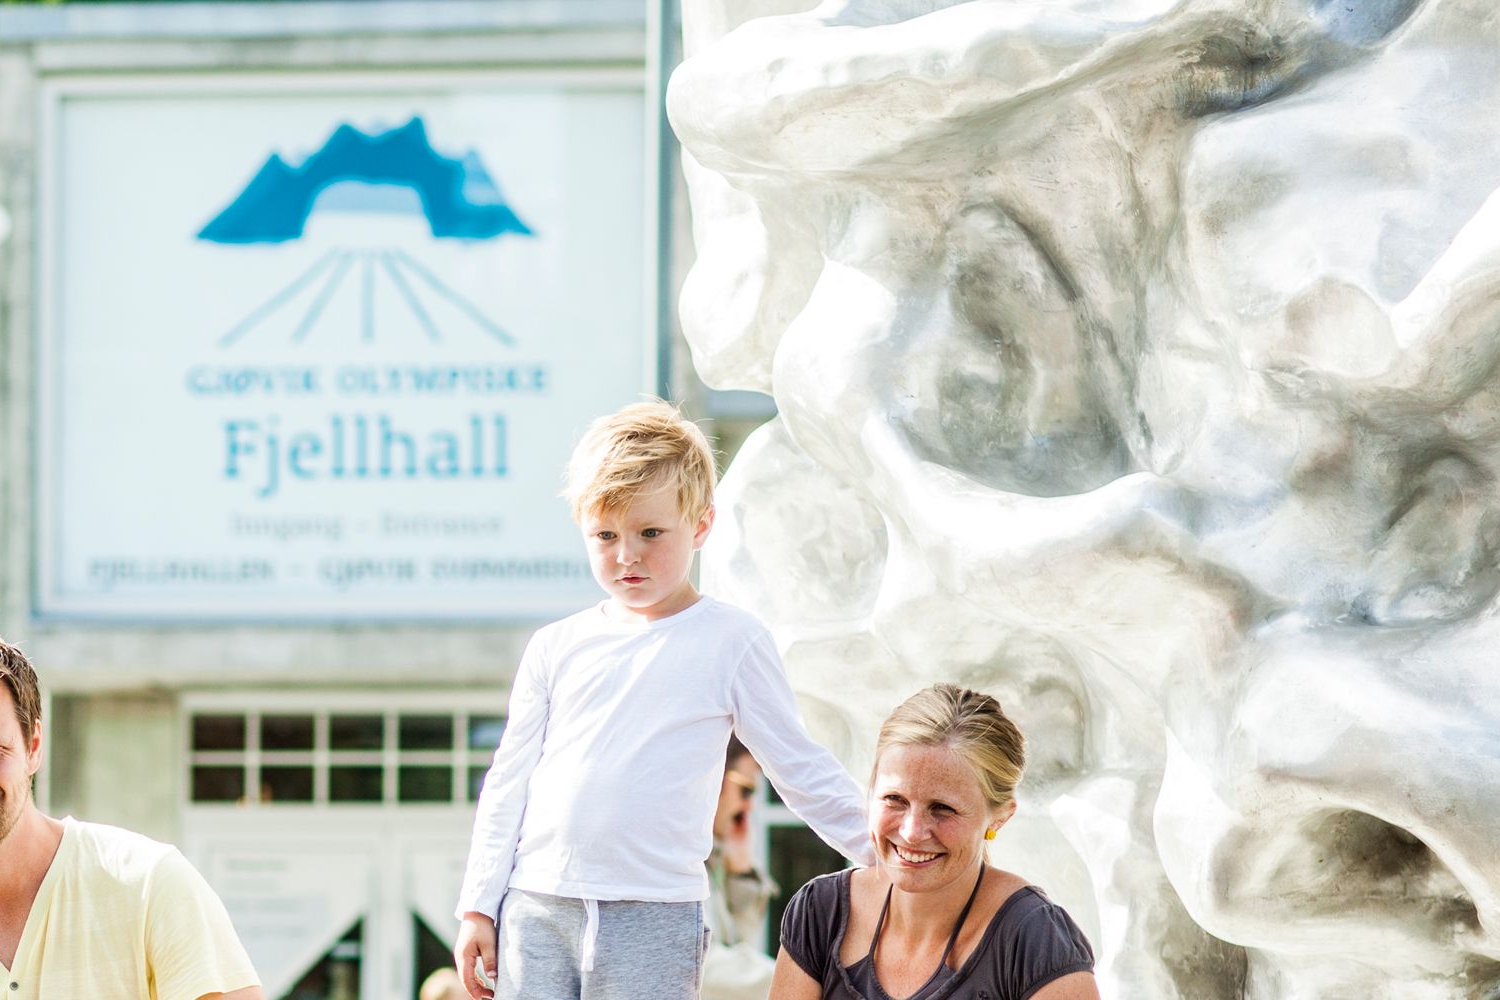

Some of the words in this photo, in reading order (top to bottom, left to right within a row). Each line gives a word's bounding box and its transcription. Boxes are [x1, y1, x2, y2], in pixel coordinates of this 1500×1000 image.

[186, 364, 319, 394] GJØVIK
[335, 364, 548, 393] OLYMPISKE
[222, 413, 510, 498] Fjellhall
